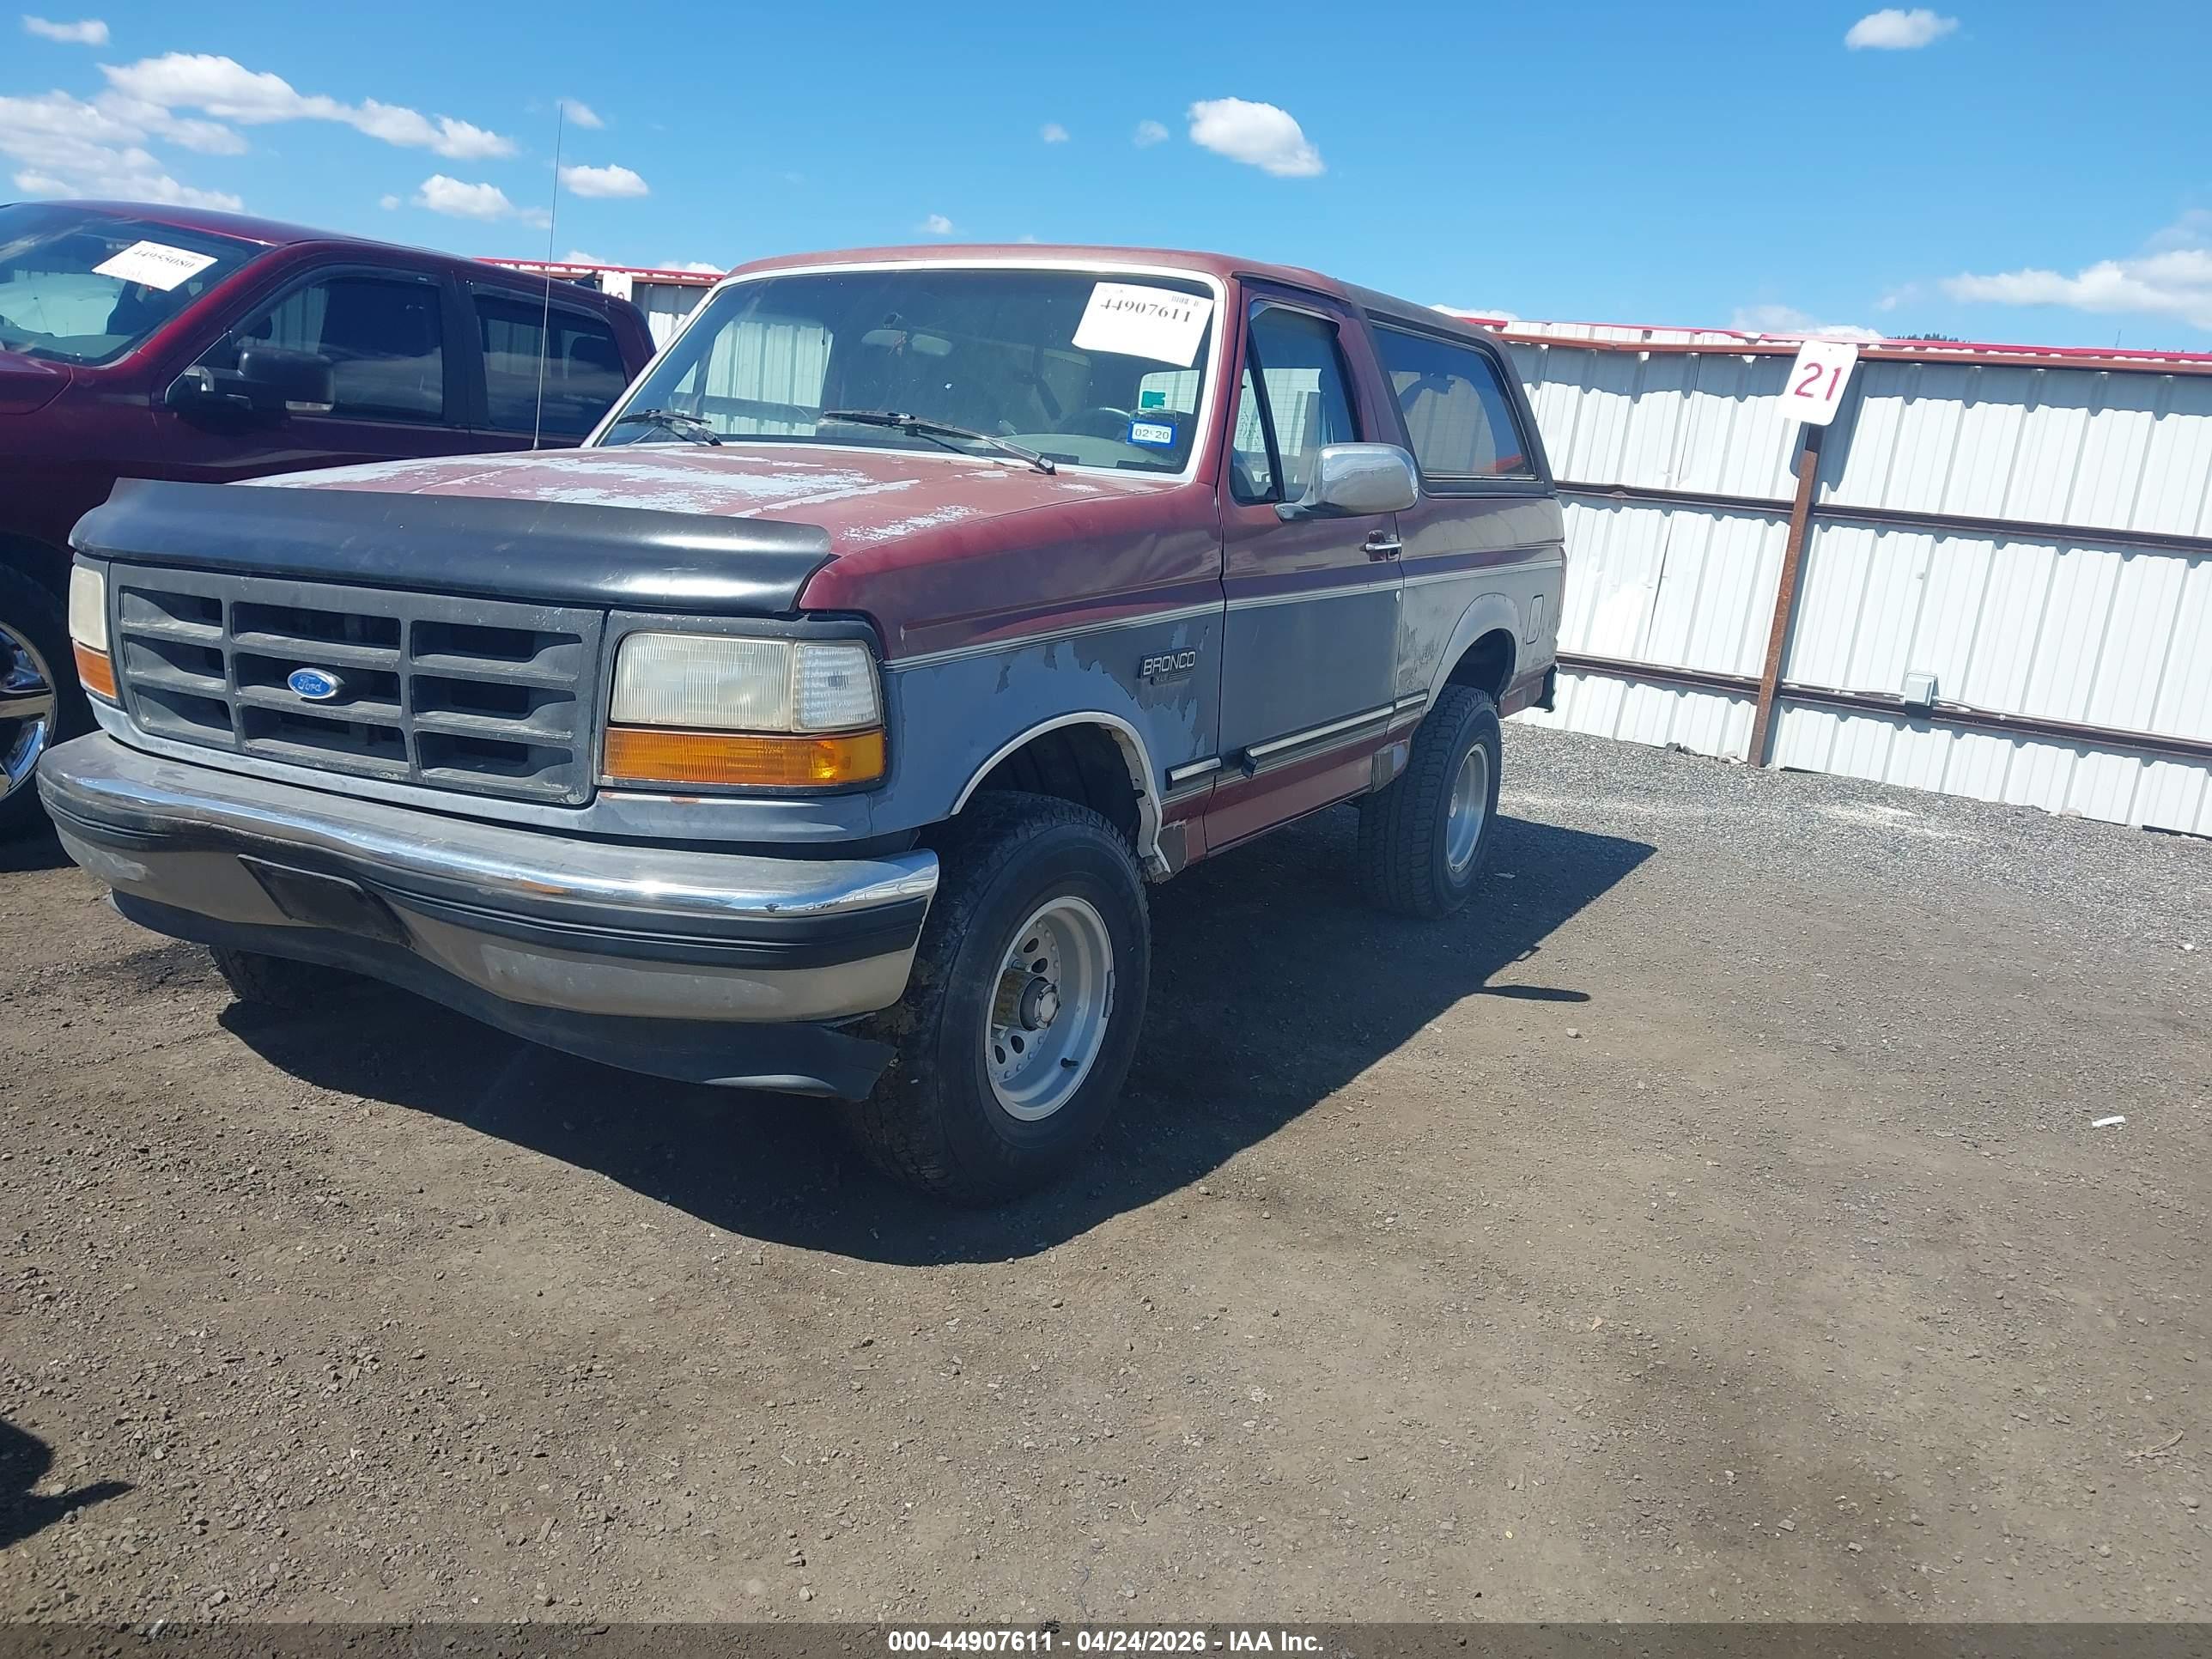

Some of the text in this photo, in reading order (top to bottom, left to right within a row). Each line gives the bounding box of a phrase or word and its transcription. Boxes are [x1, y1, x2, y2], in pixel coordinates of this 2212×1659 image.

[1100, 298, 1191, 322] 44907611
[1794, 362, 1842, 401] 21
[1143, 651, 1196, 676] BRONCO
[297, 675, 323, 692] Ford
